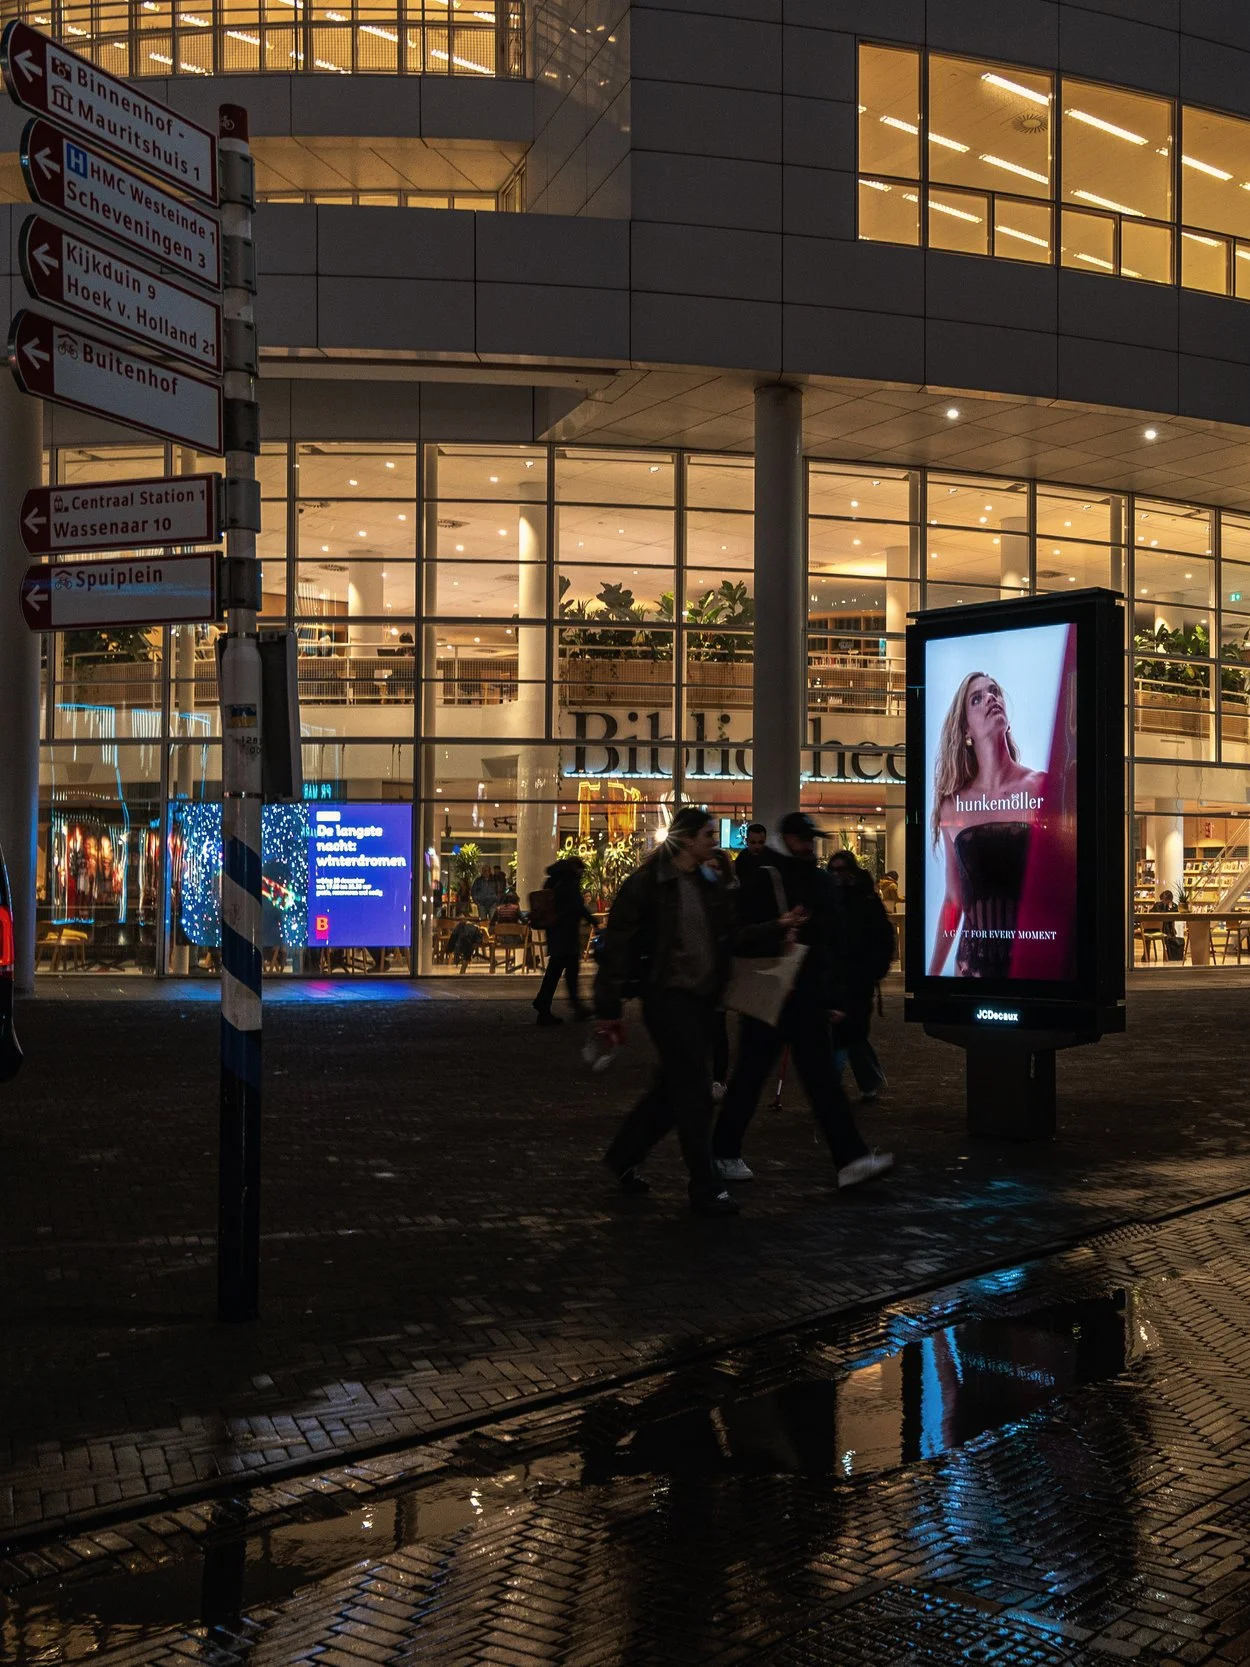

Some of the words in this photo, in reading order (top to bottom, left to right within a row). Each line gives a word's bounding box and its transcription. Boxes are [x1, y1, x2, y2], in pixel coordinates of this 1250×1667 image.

[77, 67, 174, 137] Binnenhof
[78, 99, 188, 175] Mauritshuis
[193, 167, 200, 182] 1
[90, 162, 126, 196] HMC
[129, 183, 205, 239] Westeinde
[210, 231, 216, 245] 1
[66, 180, 193, 263] Scheveningen
[198, 254, 206, 269] 3
[66, 242, 141, 294] Kijkduin
[147, 285, 156, 300] 9
[67, 275, 112, 310] Hoek
[117, 303, 131, 320] v.
[137, 306, 197, 349] Holland
[202, 339, 216, 357] 21
[83, 343, 179, 396] Buitenhof
[72, 493, 134, 511] Centraal
[140, 489, 194, 505] Station
[200, 490, 206, 501] 1
[53, 519, 149, 538] Wassenaar
[153, 517, 172, 532] 10
[75, 567, 163, 592] Spuiplein
[956, 793, 1044, 813] hunkemöller
[316, 825, 334, 837] De
[336, 825, 383, 840] langste
[316, 839, 357, 852] nacht:
[315, 854, 406, 868] winterdromen
[316, 916, 329, 931] B
[971, 930, 987, 938] FOR
[989, 930, 1016, 940] EVERY
[1018, 930, 1057, 940] MOMENT
[977, 1009, 1019, 1022] JCDecaux
